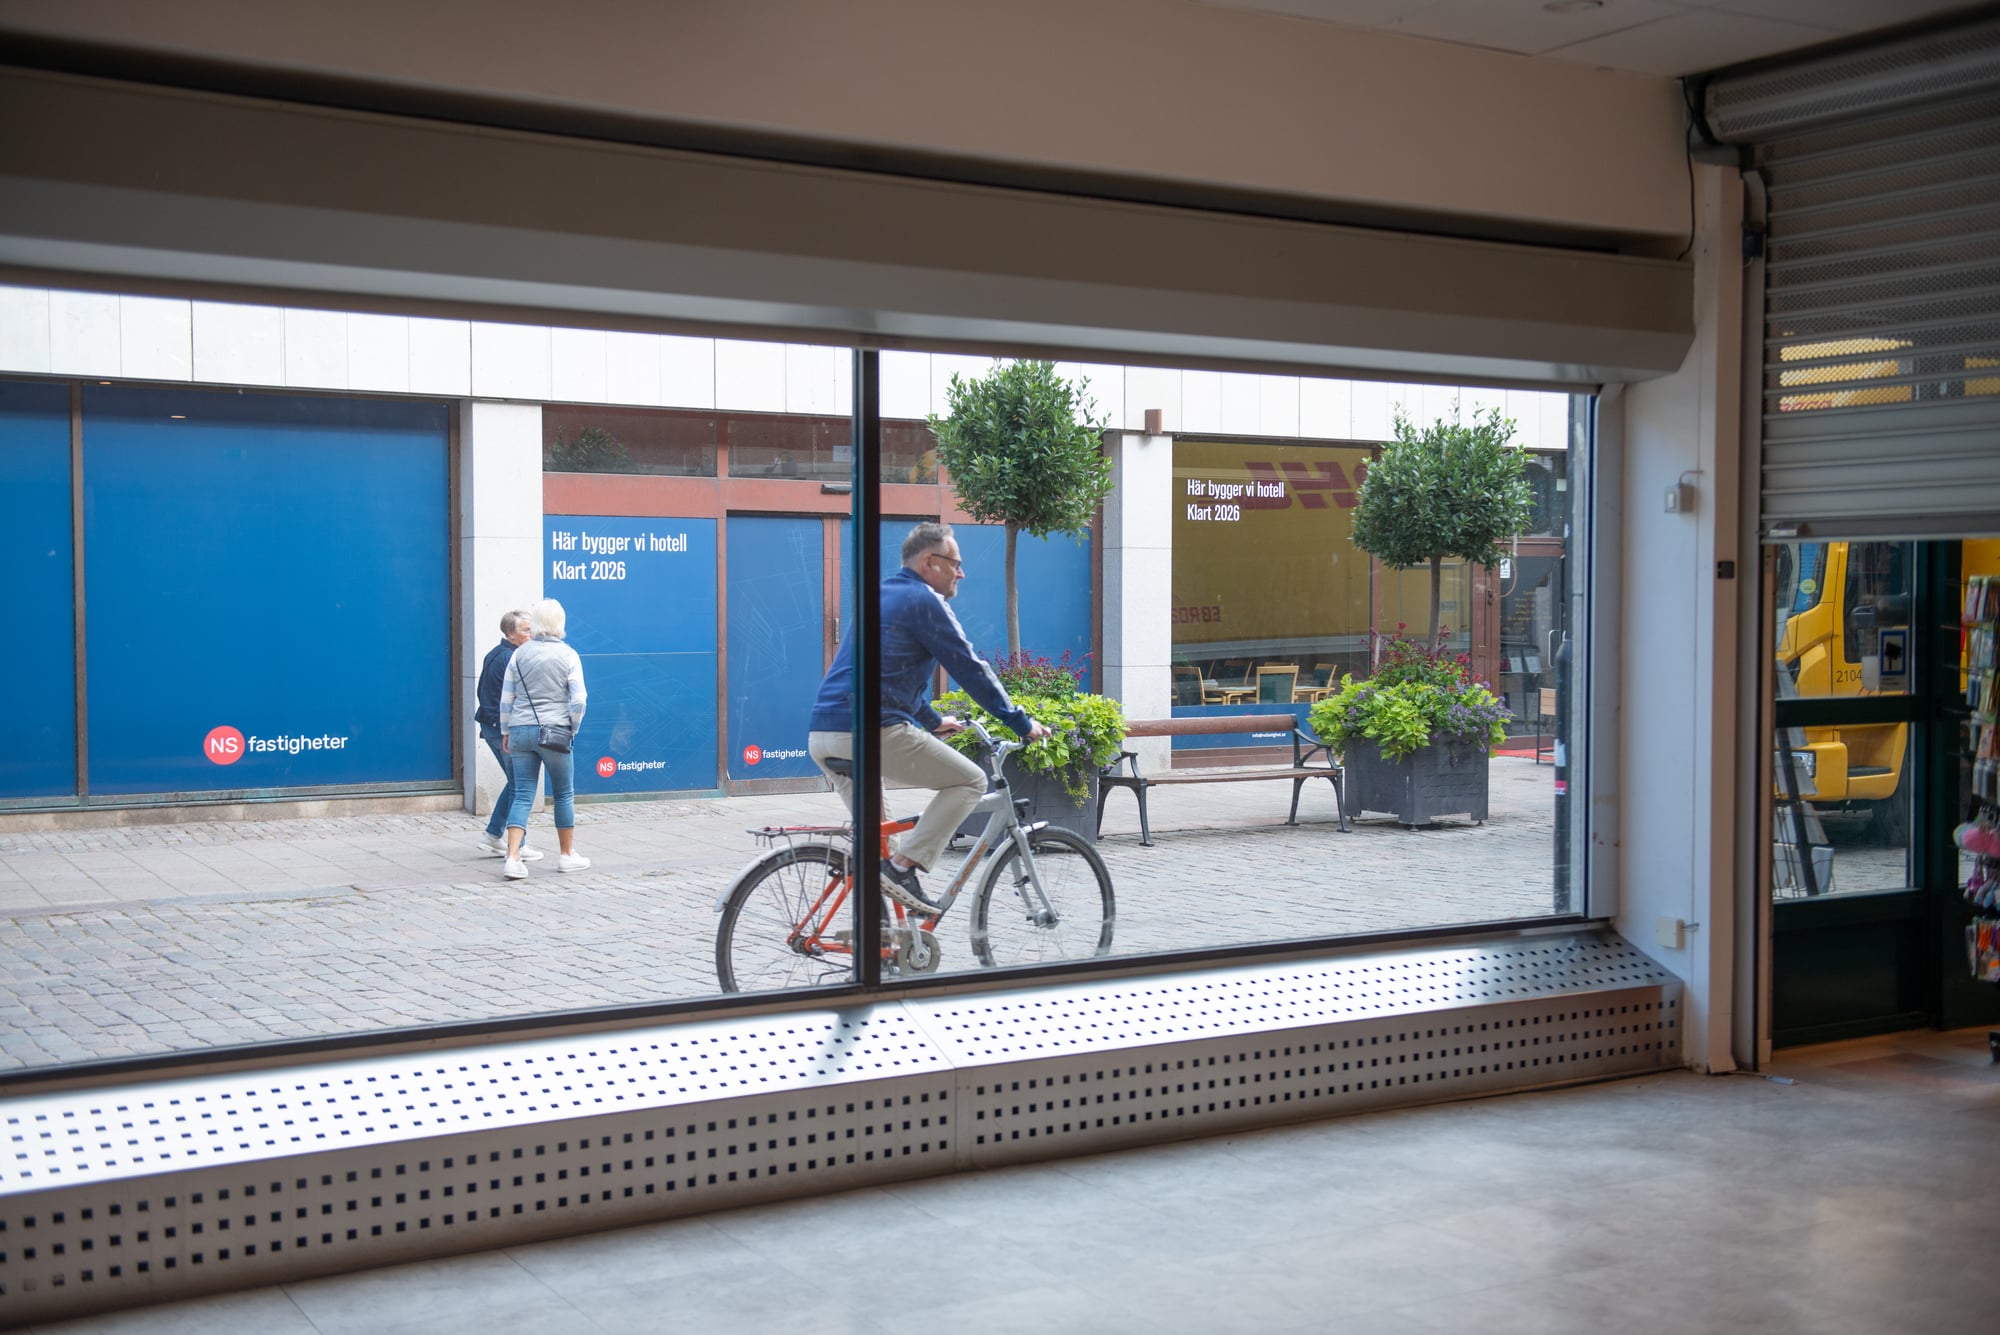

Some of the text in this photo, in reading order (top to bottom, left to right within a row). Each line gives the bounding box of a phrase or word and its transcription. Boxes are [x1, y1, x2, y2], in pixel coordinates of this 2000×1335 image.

[1187, 479, 1285, 500] Här bygger vi hotell
[1187, 504, 1240, 522] Klart 2026
[552, 531, 687, 555] Här bygger vi hotell
[552, 560, 626, 580] Klart 2026
[210, 734, 348, 755] NS fastigheter
[745, 748, 807, 760] NS fastigheter
[599, 760, 666, 772] NS fastigheter
